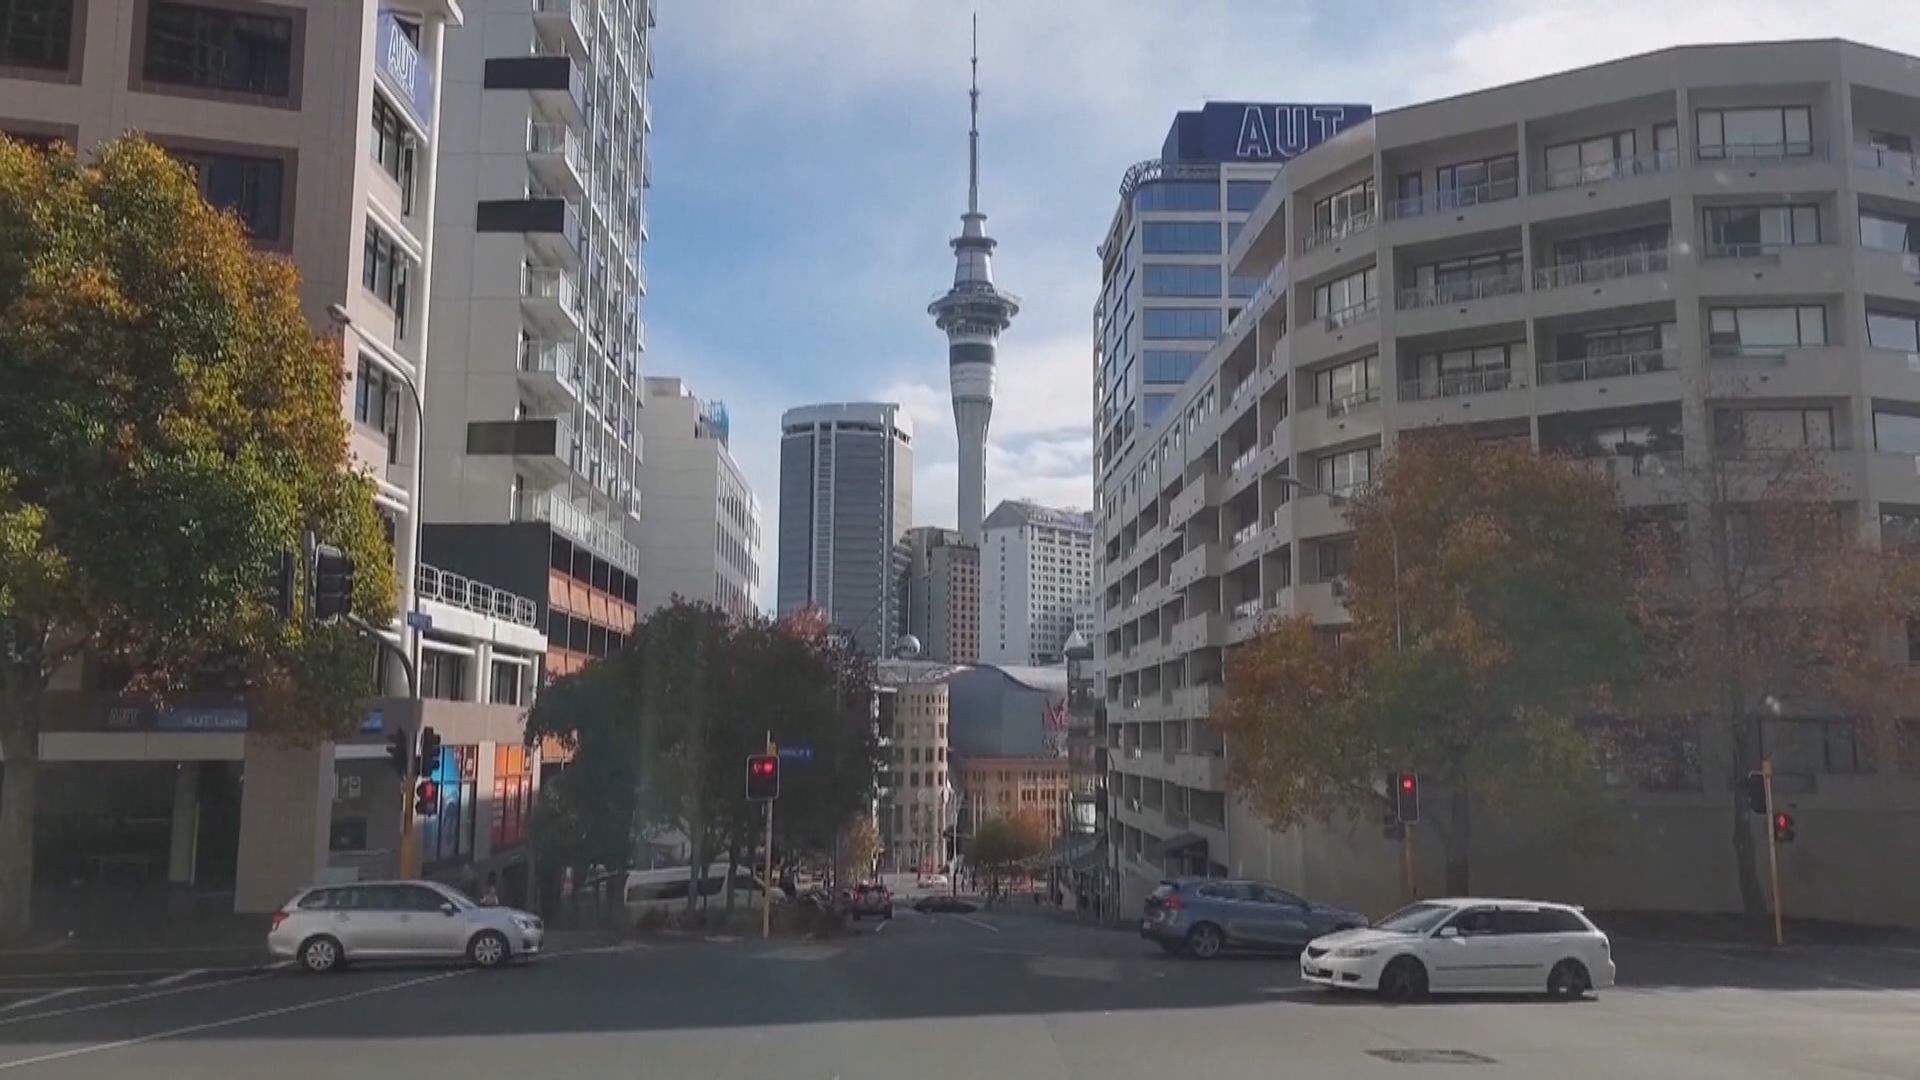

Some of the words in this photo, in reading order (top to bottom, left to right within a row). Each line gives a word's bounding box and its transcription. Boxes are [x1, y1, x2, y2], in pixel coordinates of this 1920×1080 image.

[388, 24, 417, 91] AUT
[1236, 105, 1344, 157] AUT
[184, 713, 213, 727] AUT
